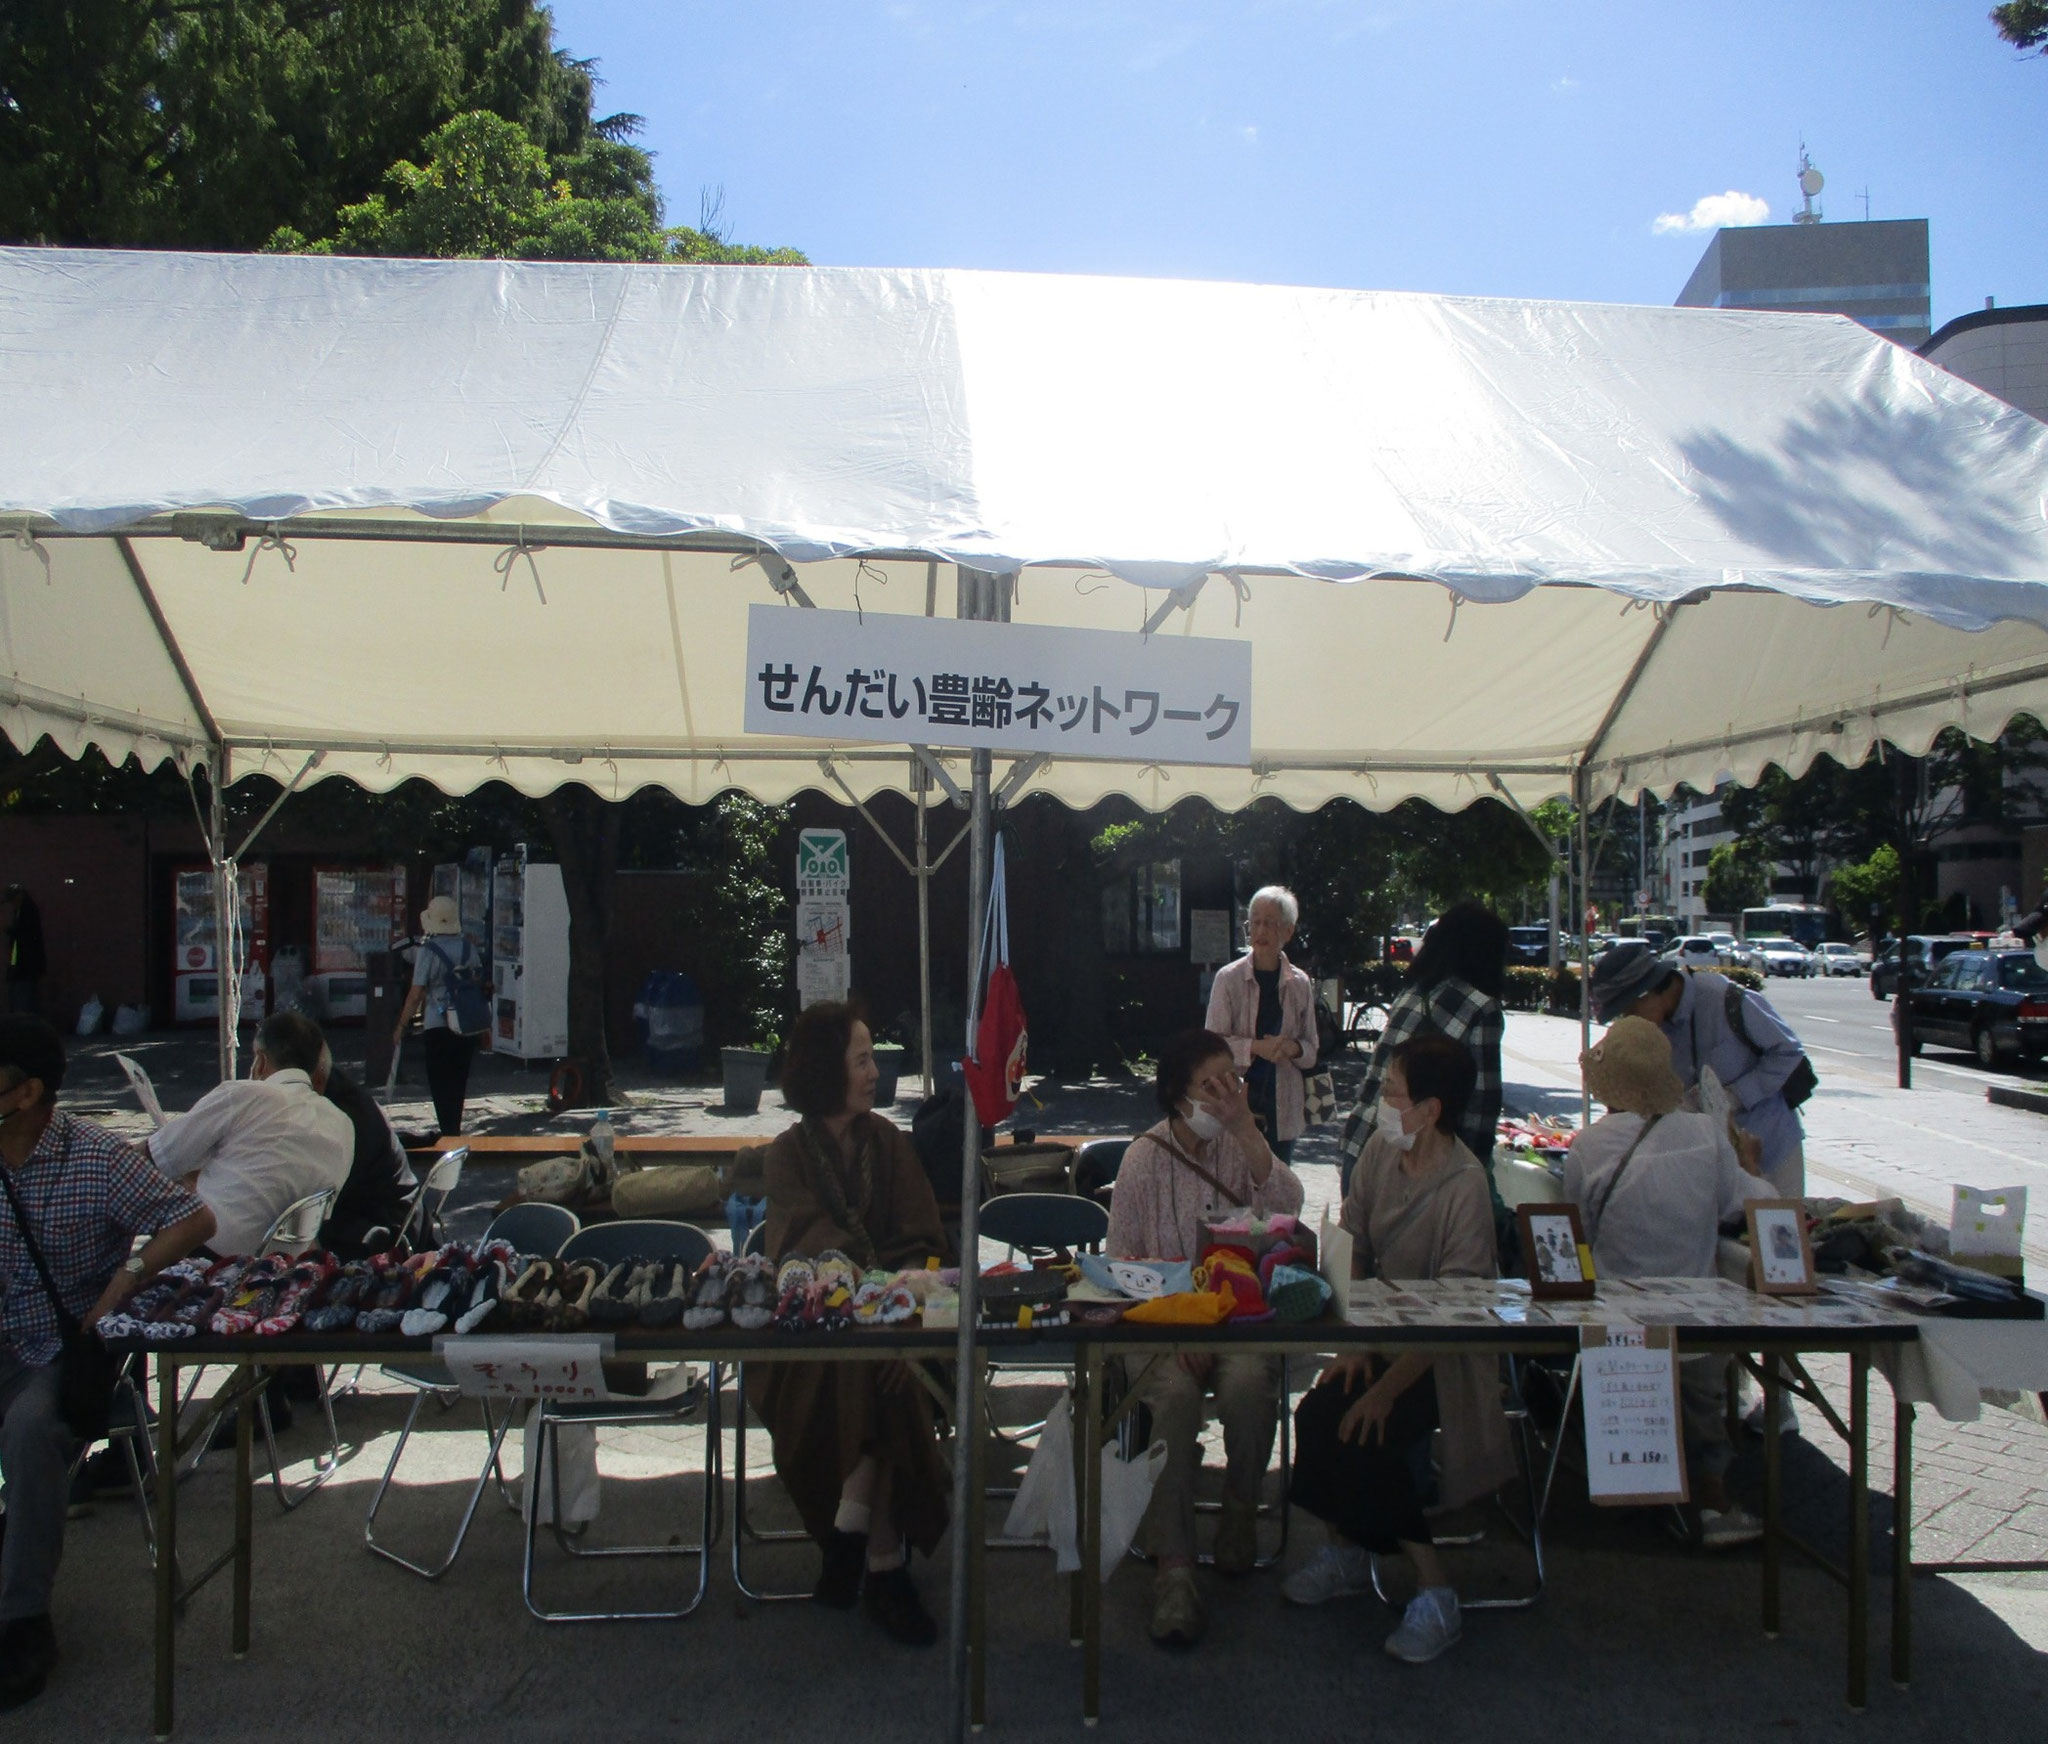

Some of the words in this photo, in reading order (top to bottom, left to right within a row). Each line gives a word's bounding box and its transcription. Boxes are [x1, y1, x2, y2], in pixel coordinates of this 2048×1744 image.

[758, 663, 1241, 741] せんだい豊齢ネットワーク
